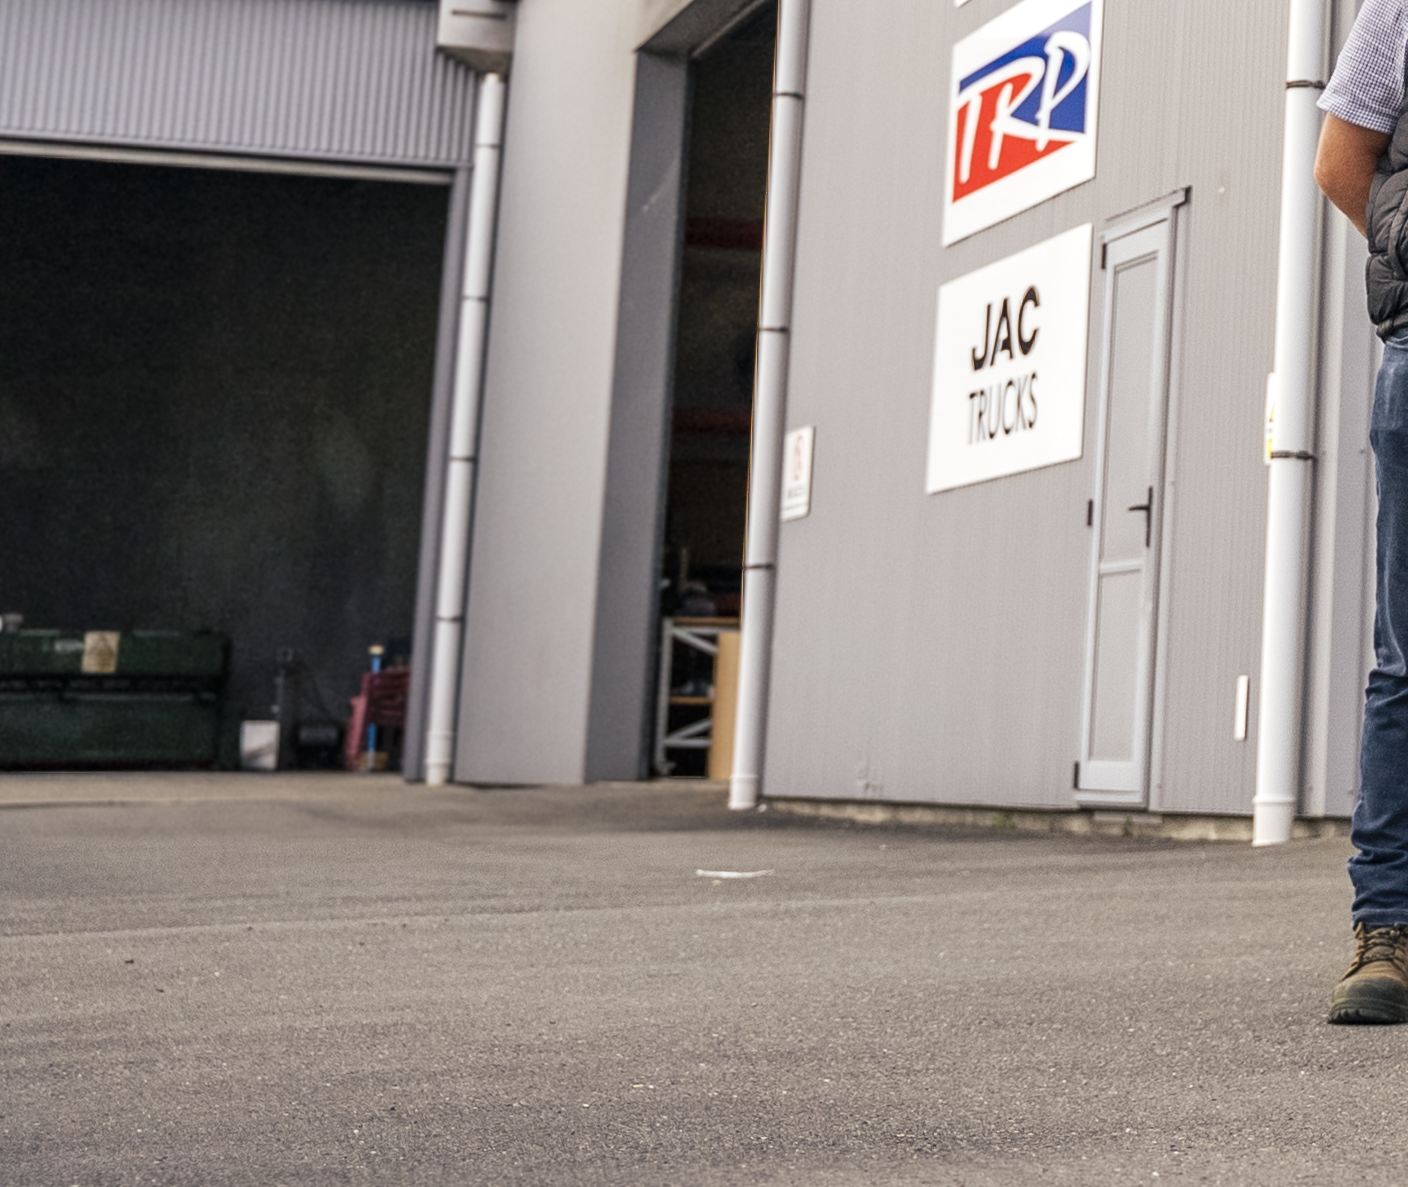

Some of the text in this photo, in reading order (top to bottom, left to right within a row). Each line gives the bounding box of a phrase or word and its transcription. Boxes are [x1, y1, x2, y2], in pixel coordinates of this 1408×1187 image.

[957, 30, 1091, 184] TRP
[971, 286, 1040, 371] JAC
[967, 371, 1039, 445] TRUCKS
